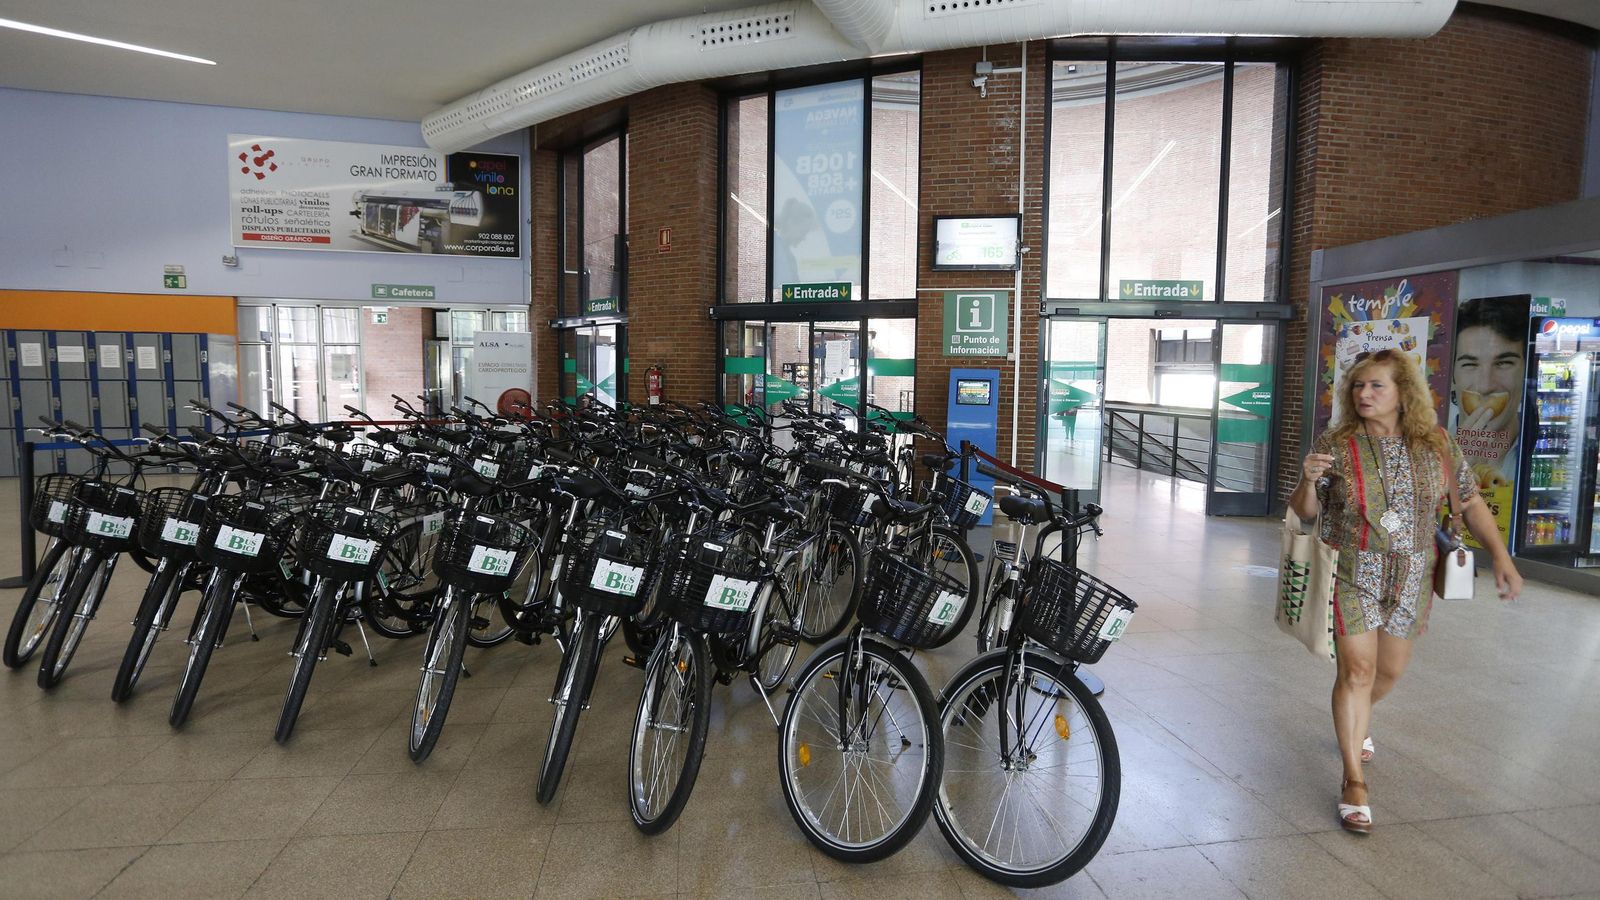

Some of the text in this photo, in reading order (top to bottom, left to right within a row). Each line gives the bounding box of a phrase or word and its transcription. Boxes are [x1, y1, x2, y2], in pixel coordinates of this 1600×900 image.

[380, 154, 437, 168] IMPRESIÓN
[350, 165, 437, 181] GRAN FORMATO
[474, 171, 505, 183] vinilo
[486, 184, 514, 195] lona
[299, 198, 330, 206] vinilos
[241, 205, 284, 216] roll-ups
[241, 214, 331, 227] rótulos señalética
[276, 226, 331, 234] PUBLICITARIOS
[443, 244, 515, 253] www.corporalia.es
[982, 246, 1004, 258] 165
[794, 287, 839, 299] Entrada
[1134, 283, 1189, 297] Entrada
[1348, 279, 1414, 318] temple
[591, 301, 612, 312] Entrada
[1557, 323, 1590, 336] pepsi
[963, 335, 1000, 344] Punto de
[1366, 330, 1393, 342] Prensa
[950, 345, 1000, 354] Información
[1456, 427, 1510, 439] Empieza el
[1471, 440, 1488, 448] con
[1491, 442, 1510, 450] una
[1462, 448, 1498, 459] sonrisa
